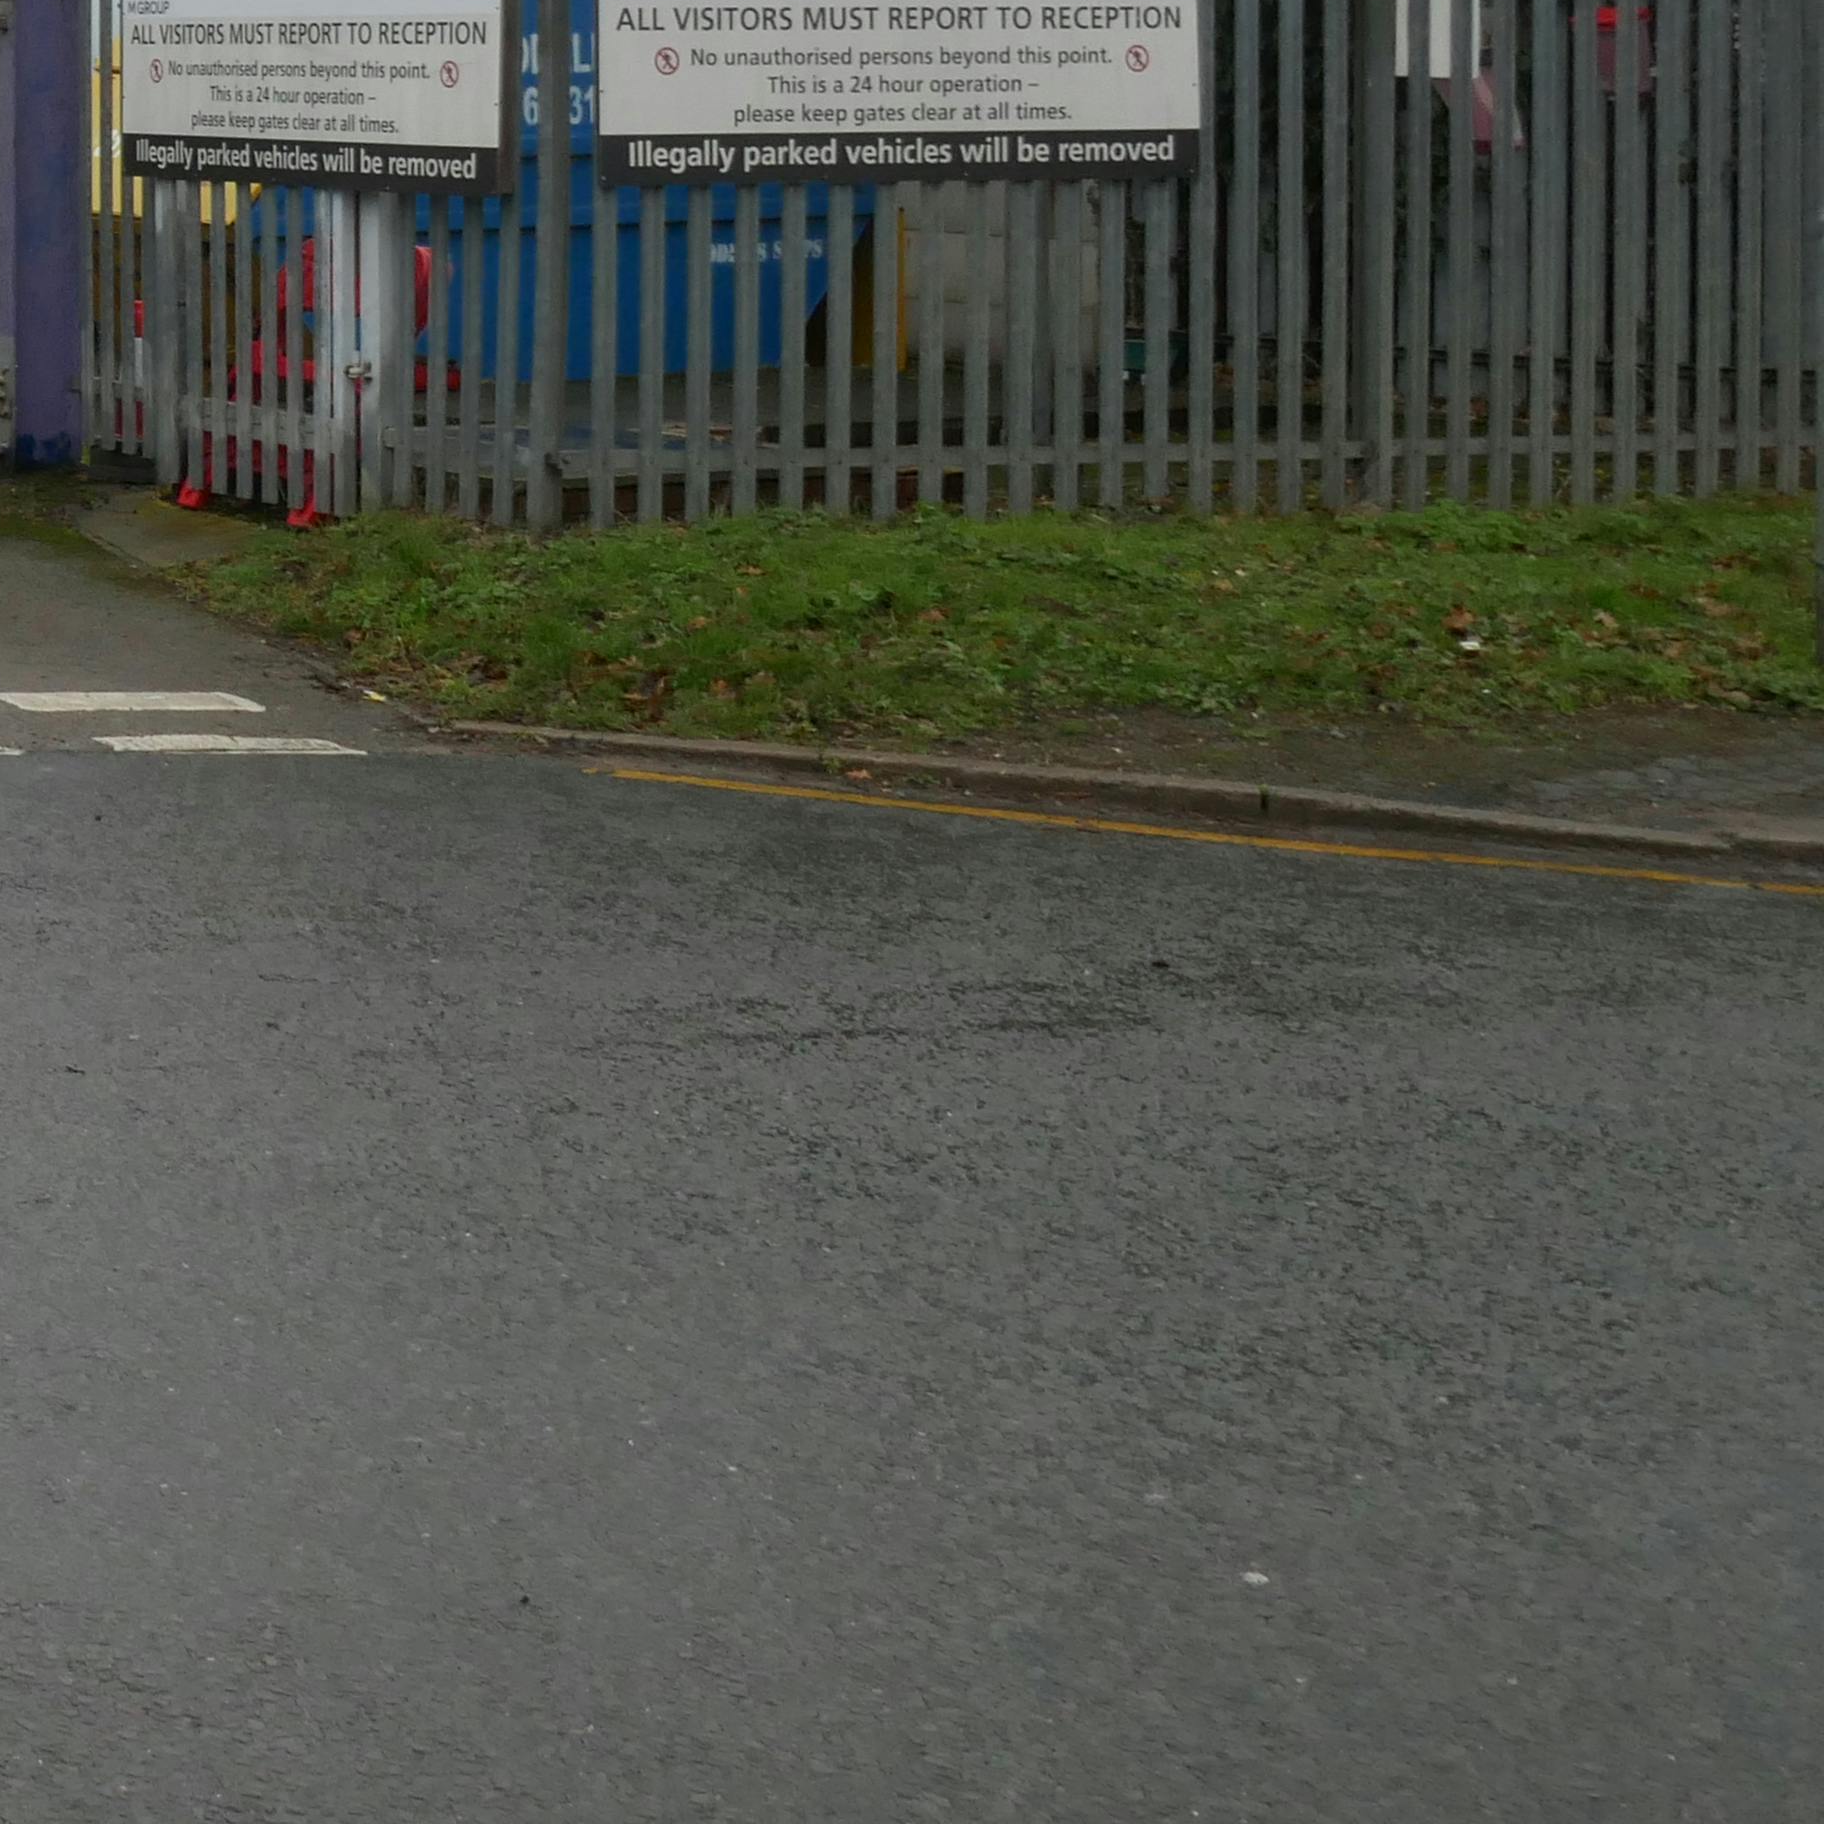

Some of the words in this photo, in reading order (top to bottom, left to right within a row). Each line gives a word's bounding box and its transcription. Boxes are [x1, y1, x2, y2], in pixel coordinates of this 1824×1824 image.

[137, 1, 170, 15] GROUP
[616, 7, 666, 31] ALL
[673, 7, 793, 32] VISITORS
[803, 7, 880, 32] MUST
[888, 6, 988, 30] REPORT
[995, 6, 1033, 30] TO
[1041, 6, 1182, 30] RECEPTION
[131, 24, 156, 46] ALL
[159, 23, 224, 46] VISITORS
[229, 23, 274, 45] MUST
[278, 22, 342, 45] REPORT
[347, 22, 373, 45] TO
[378, 21, 487, 45] RECEPTION
[690, 48, 717, 66] No
[724, 47, 852, 66] unauthorised
[859, 50, 933, 69] persons
[940, 46, 1011, 69] beyond
[1017, 46, 1052, 65] this
[1057, 46, 1112, 68] point.
[168, 60, 183, 76] No
[186, 60, 258, 77] unauthorised
[261, 63, 306, 81] persons
[309, 60, 358, 82] beyond
[361, 61, 385, 79] this
[389, 61, 431, 83] point.
[210, 85, 232, 103] This
[235, 85, 244, 103] is
[246, 91, 253, 103] a
[256, 87, 270, 103] 24
[273, 87, 300, 104] hour
[303, 87, 364, 108] operation
[767, 76, 806, 94] This
[812, 76, 827, 94] is
[833, 81, 844, 94] a
[850, 76, 873, 93] 24
[879, 75, 923, 93] hour
[929, 76, 1022, 97] operation
[191, 110, 226, 130] please
[229, 111, 256, 133] keep
[259, 114, 290, 133] gates
[292, 113, 321, 131] clear
[324, 116, 337, 132] at
[340, 114, 355, 133] all
[359, 115, 400, 134] times.
[734, 104, 795, 127] please
[802, 103, 848, 126] keep
[855, 106, 906, 127] gates
[911, 103, 957, 121] clear
[963, 105, 981, 121] at
[987, 102, 1009, 121] all
[1016, 103, 1073, 121] times.
[136, 138, 193, 170] Illegally
[197, 141, 250, 170] parked
[254, 144, 318, 172] vehicles
[322, 146, 355, 173] will
[360, 147, 383, 175] be
[388, 152, 477, 180] removed
[628, 139, 736, 174] Illegally
[743, 137, 837, 173] parked
[845, 137, 952, 165] vehicles
[959, 136, 1008, 164] will
[1017, 135, 1050, 163] be
[1058, 134, 1175, 162] removed
